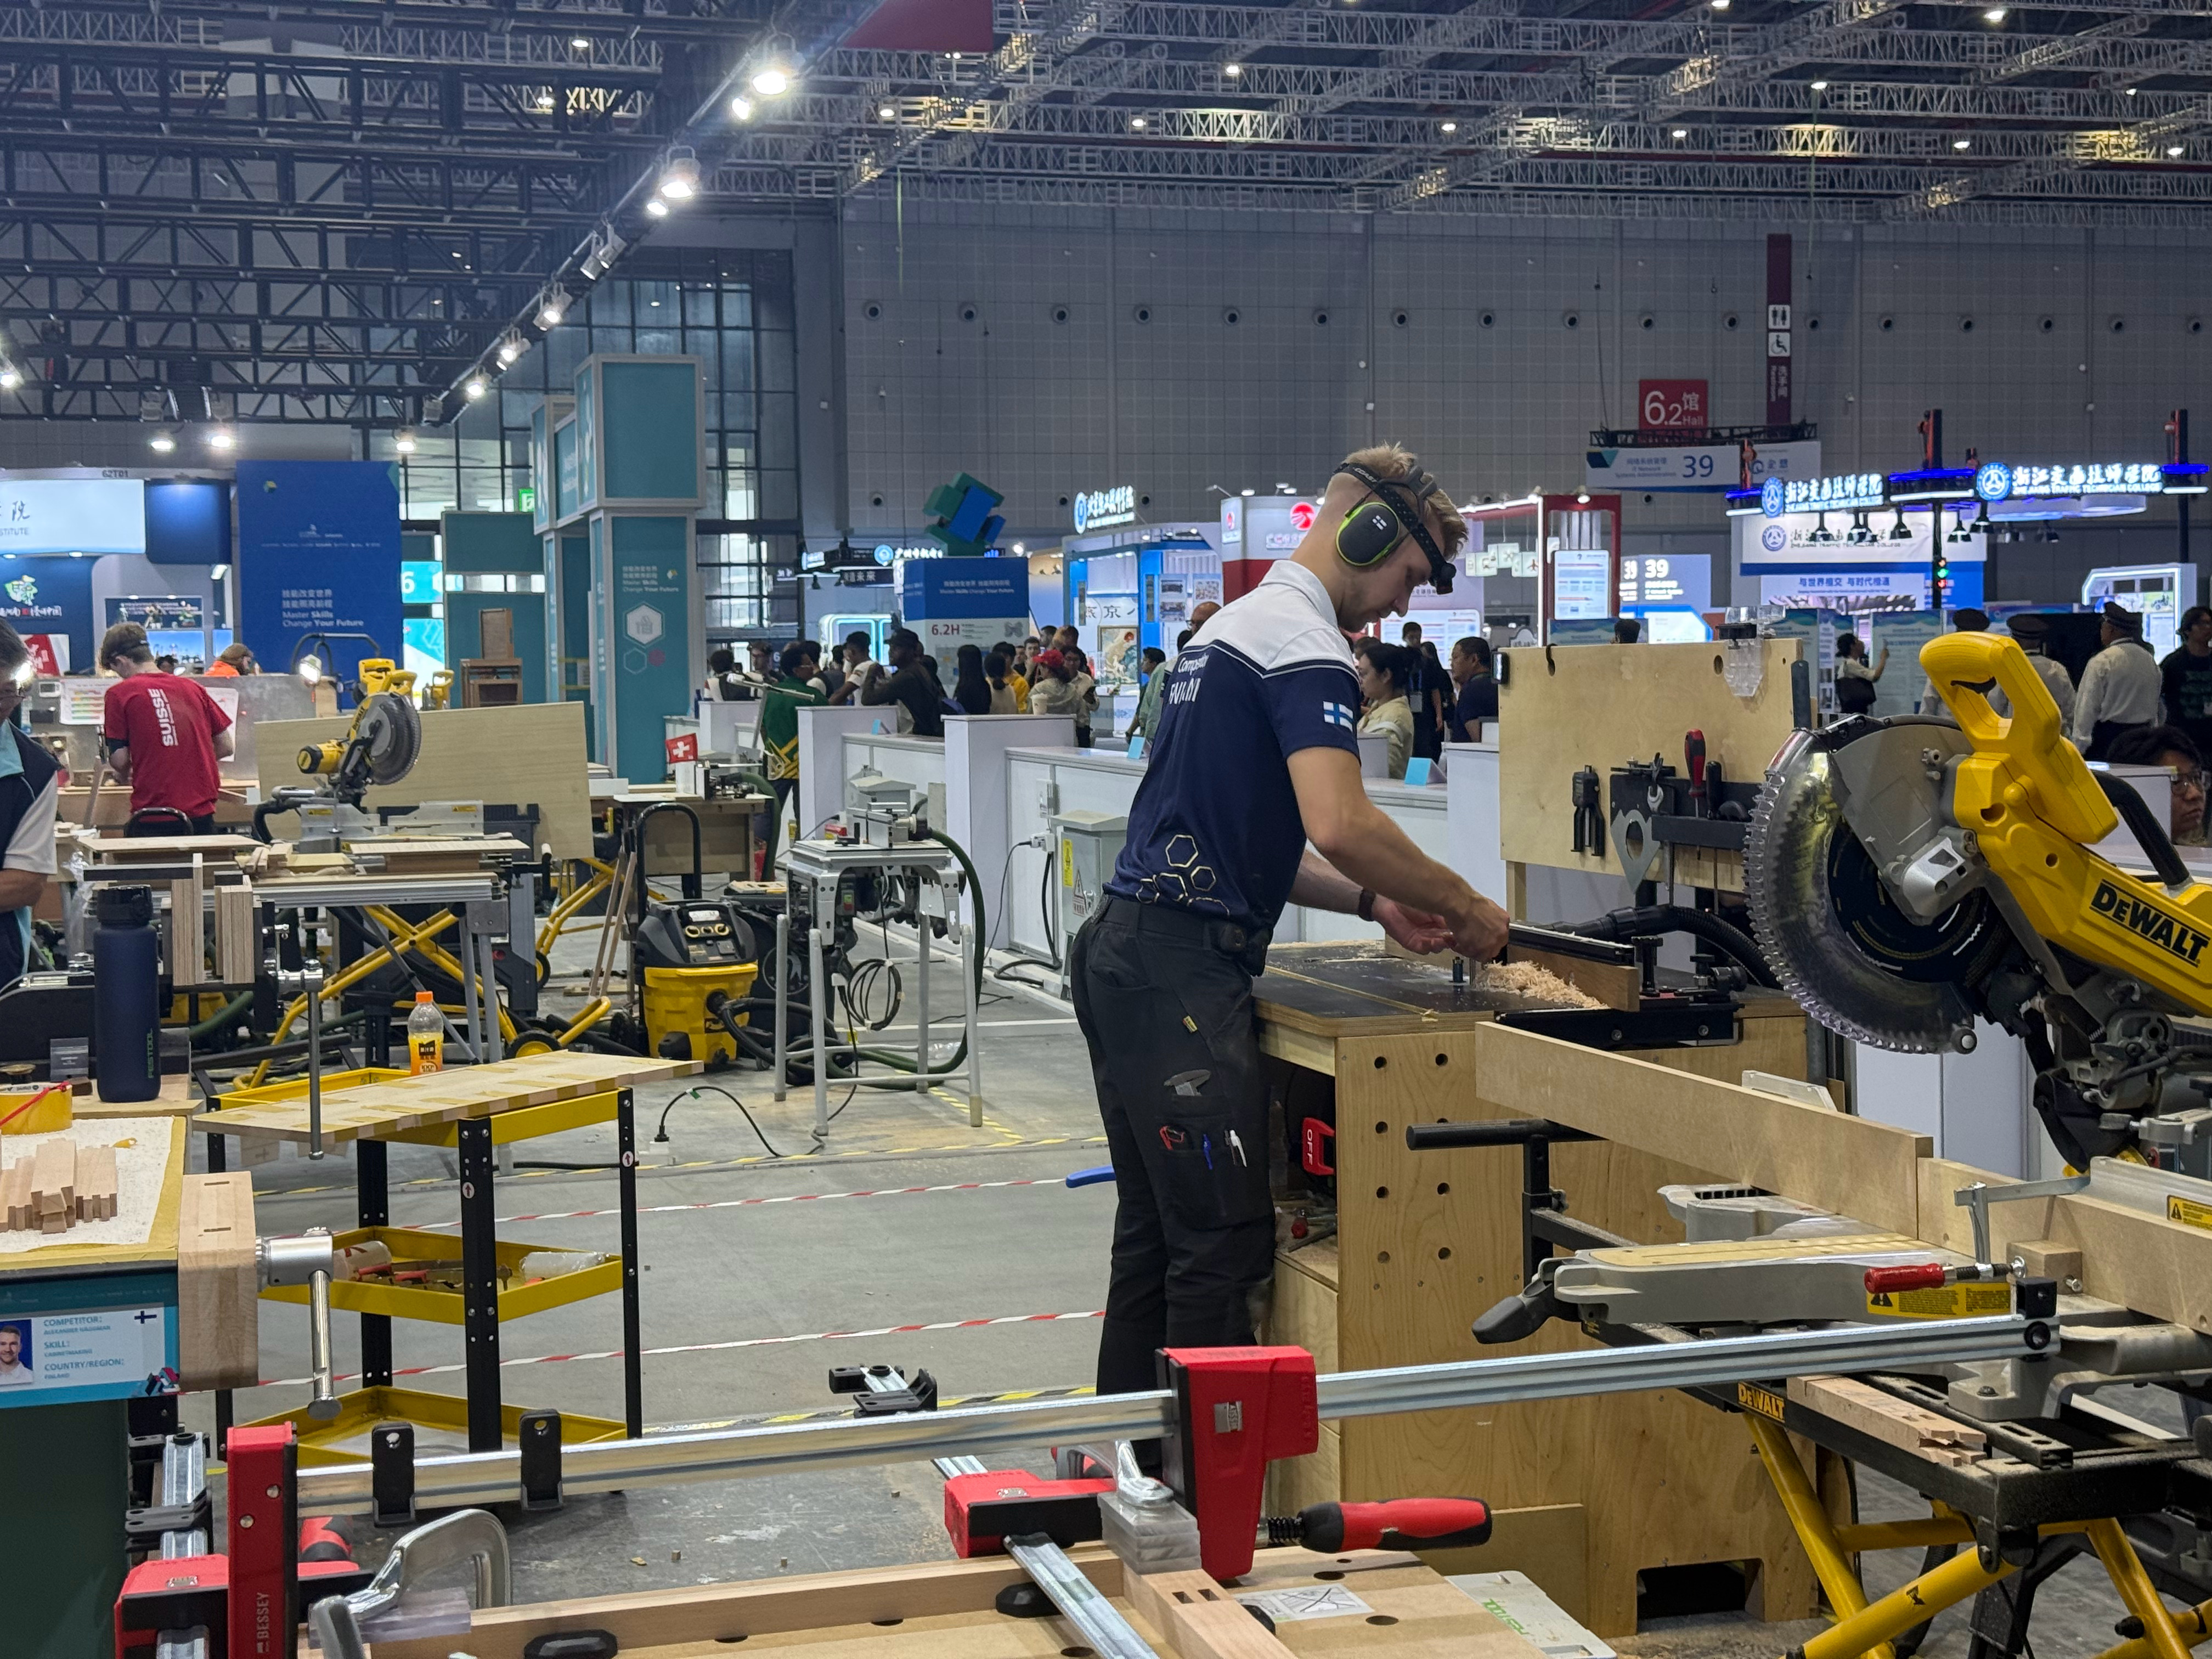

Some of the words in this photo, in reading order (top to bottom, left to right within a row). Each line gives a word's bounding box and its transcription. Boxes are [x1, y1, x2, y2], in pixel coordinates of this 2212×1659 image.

[1682, 392, 1700, 410] 馆
[1683, 416, 1703, 426] Hall
[1683, 455, 1714, 478] 39
[1645, 559, 1669, 578] 39
[282, 620, 313, 629] Change
[932, 624, 960, 636] 6.2H
[147, 688, 174, 747] SUISSE
[44, 1316, 103, 1327] COMPETITOR:
[44, 1341, 70, 1349] SKILL:
[44, 1358, 125, 1371] COUNTRY/REGION:
[257, 1592, 269, 1639] BESSEY
